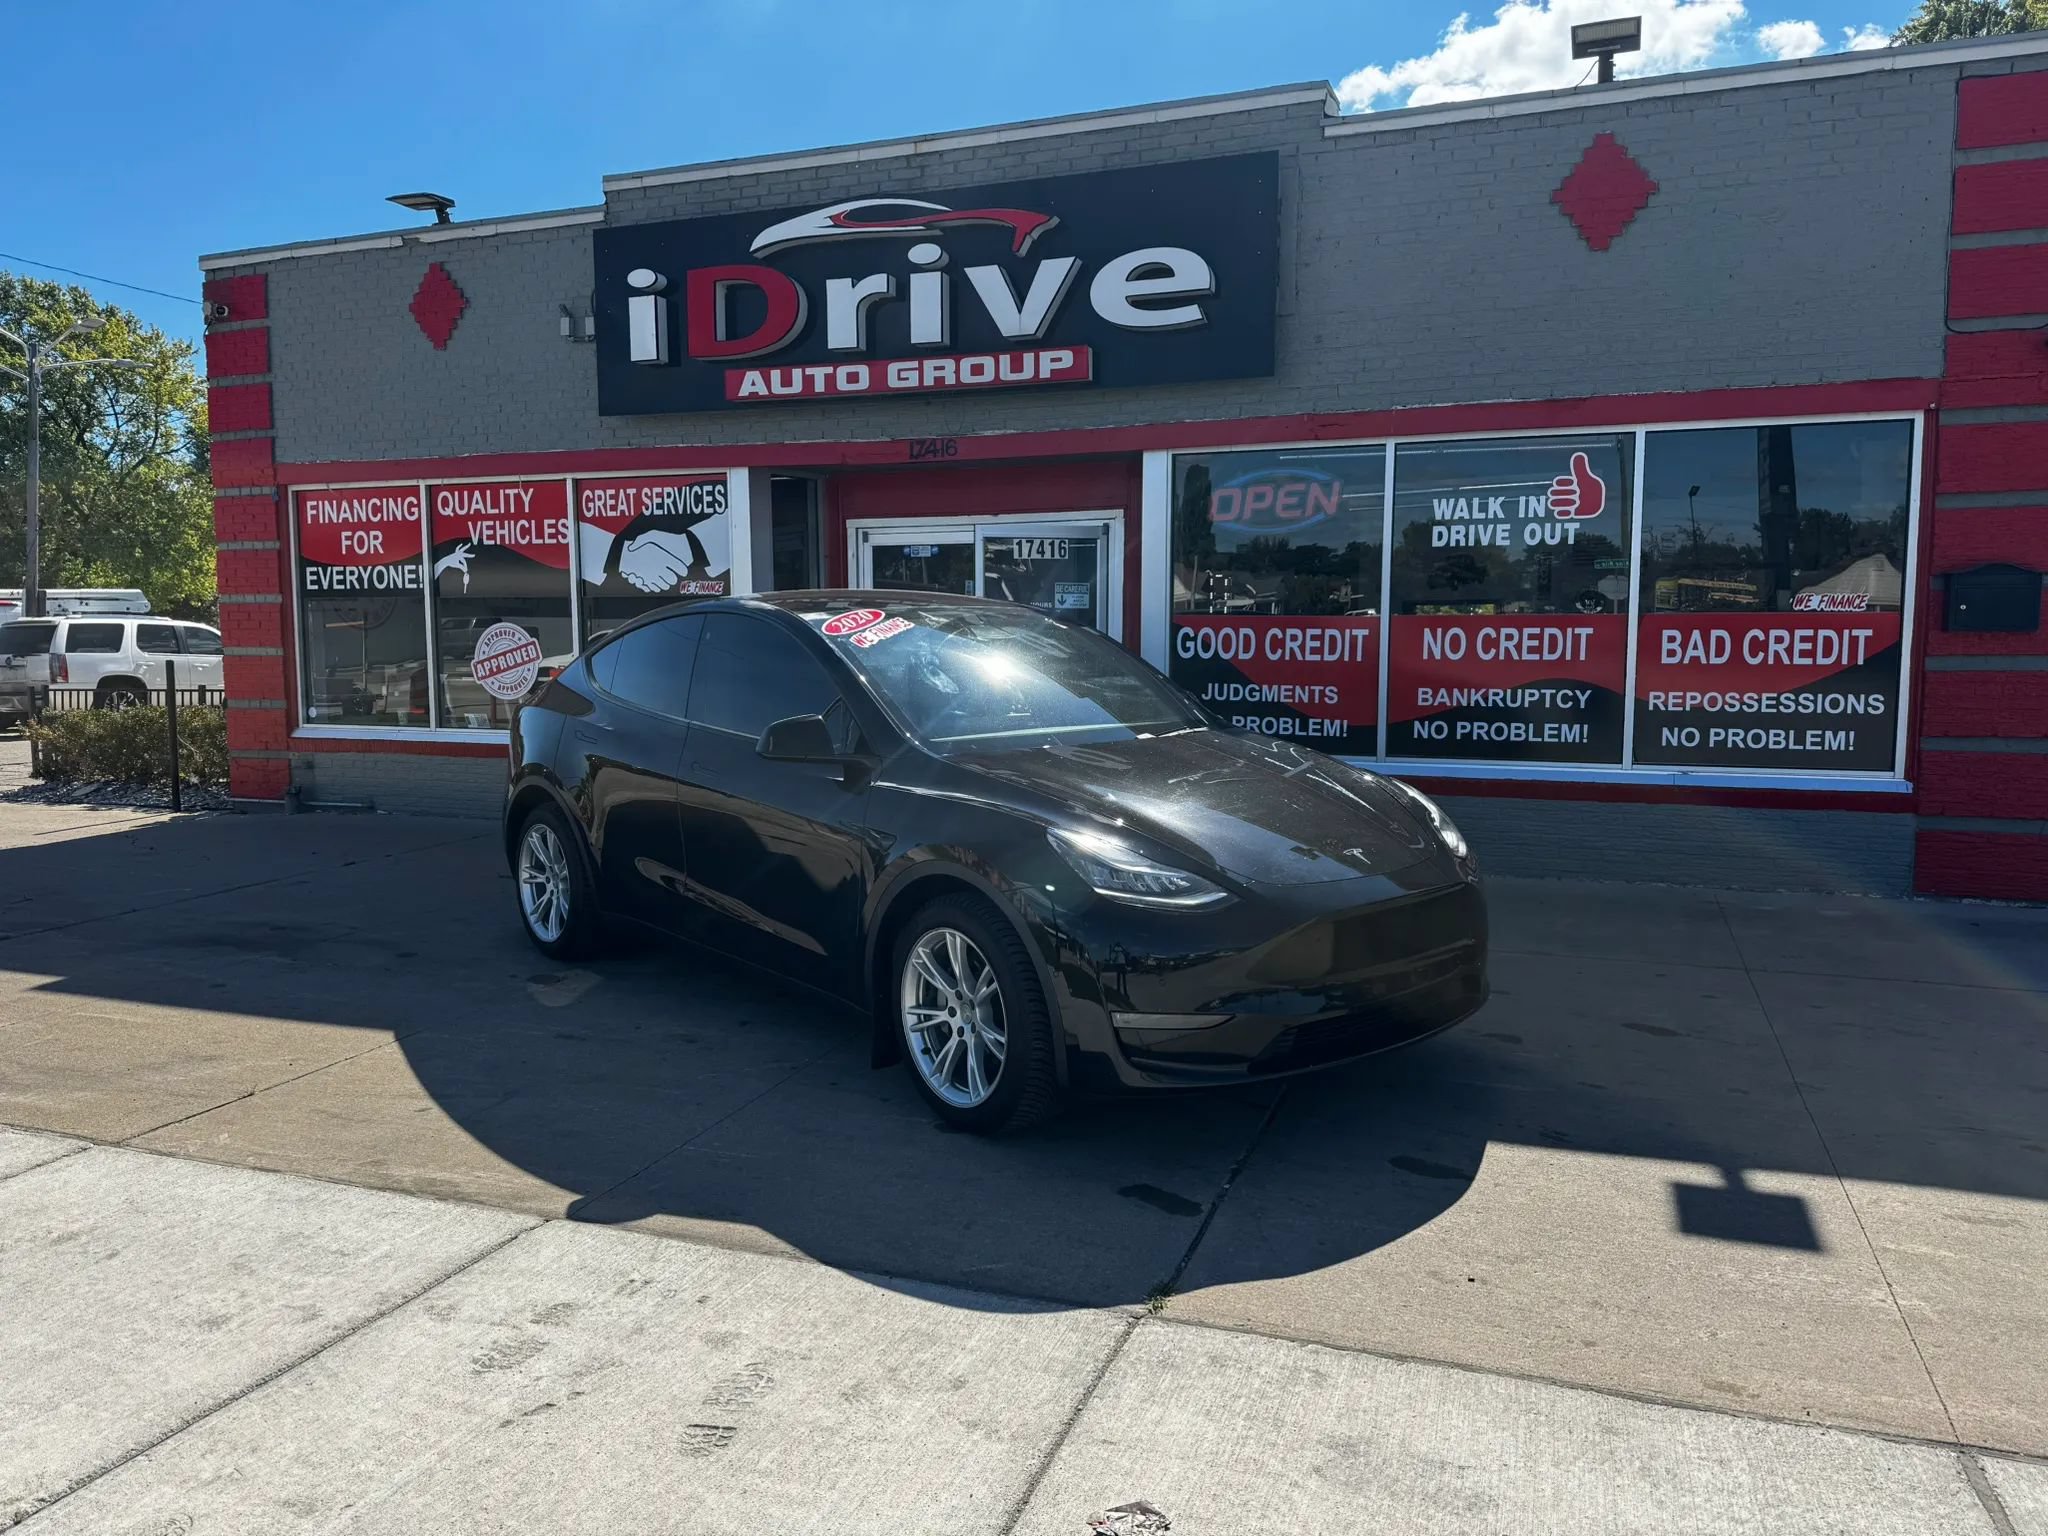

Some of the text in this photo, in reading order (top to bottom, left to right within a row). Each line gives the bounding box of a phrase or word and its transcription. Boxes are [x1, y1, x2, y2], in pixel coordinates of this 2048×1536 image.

[627, 242, 1217, 365] iDrive
[738, 348, 1076, 397] AUTO GROUP
[305, 496, 420, 525] FINANCING
[436, 487, 534, 518] QUALITY
[581, 484, 727, 518] GREAT SERVICES
[1209, 481, 1341, 522] OPEN
[1432, 494, 1546, 521] WALK IN
[341, 530, 384, 556] FOR
[467, 518, 570, 546] VEHICLES
[1431, 521, 1581, 548] DRIVE OUT
[1015, 539, 1068, 558] 17416
[305, 564, 424, 591] EVERYONE!
[680, 580, 724, 595] WE FINANCE
[1793, 593, 1869, 610] WE FINANCE
[831, 609, 874, 633] 2020
[484, 629, 517, 648] APPROVED
[1176, 626, 1369, 662] GOOD CREDIT
[1422, 627, 1594, 662] NO CREDIT
[1661, 628, 1873, 666] BAD CREDIT
[476, 644, 537, 678] APPROVED
[497, 675, 529, 693] APPROVED
[1201, 682, 1339, 705] JUDGMENTS
[1417, 687, 1593, 710] BANKRUPTCY
[1648, 691, 1886, 715] REPOSSESSIONS
[1231, 715, 1348, 738] PROBLEM!
[1413, 720, 1589, 744] NO PROBLEM!
[1661, 726, 1856, 752] NO PROBLEM!
